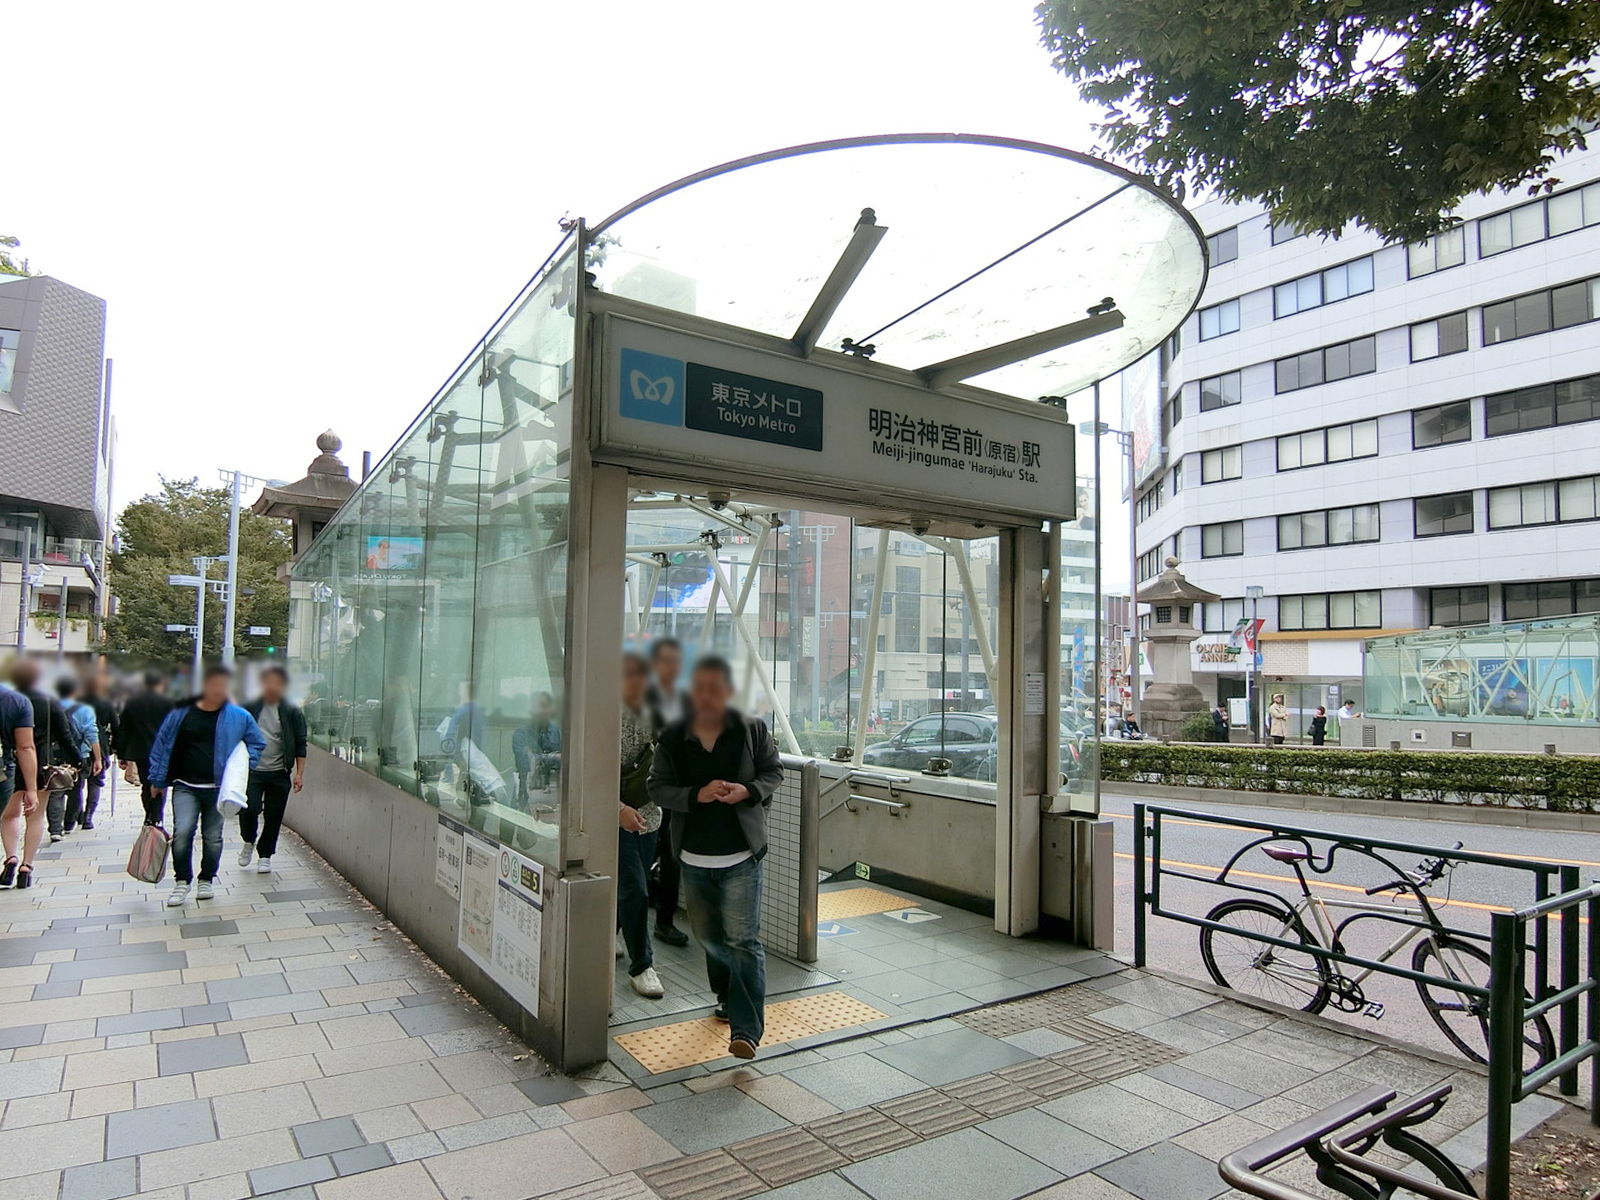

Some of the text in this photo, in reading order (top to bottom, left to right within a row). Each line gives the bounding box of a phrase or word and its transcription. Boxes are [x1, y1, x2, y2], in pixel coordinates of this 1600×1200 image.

[711, 382, 802, 418] 東京メトロ
[717, 406, 797, 434] Tokyo Metro
[872, 440, 965, 470] Meiji-jingumae
[1018, 468, 1038, 484] Sta.
[1200, 653, 1237, 663] ANNEX
[532, 872, 538, 891] 5
